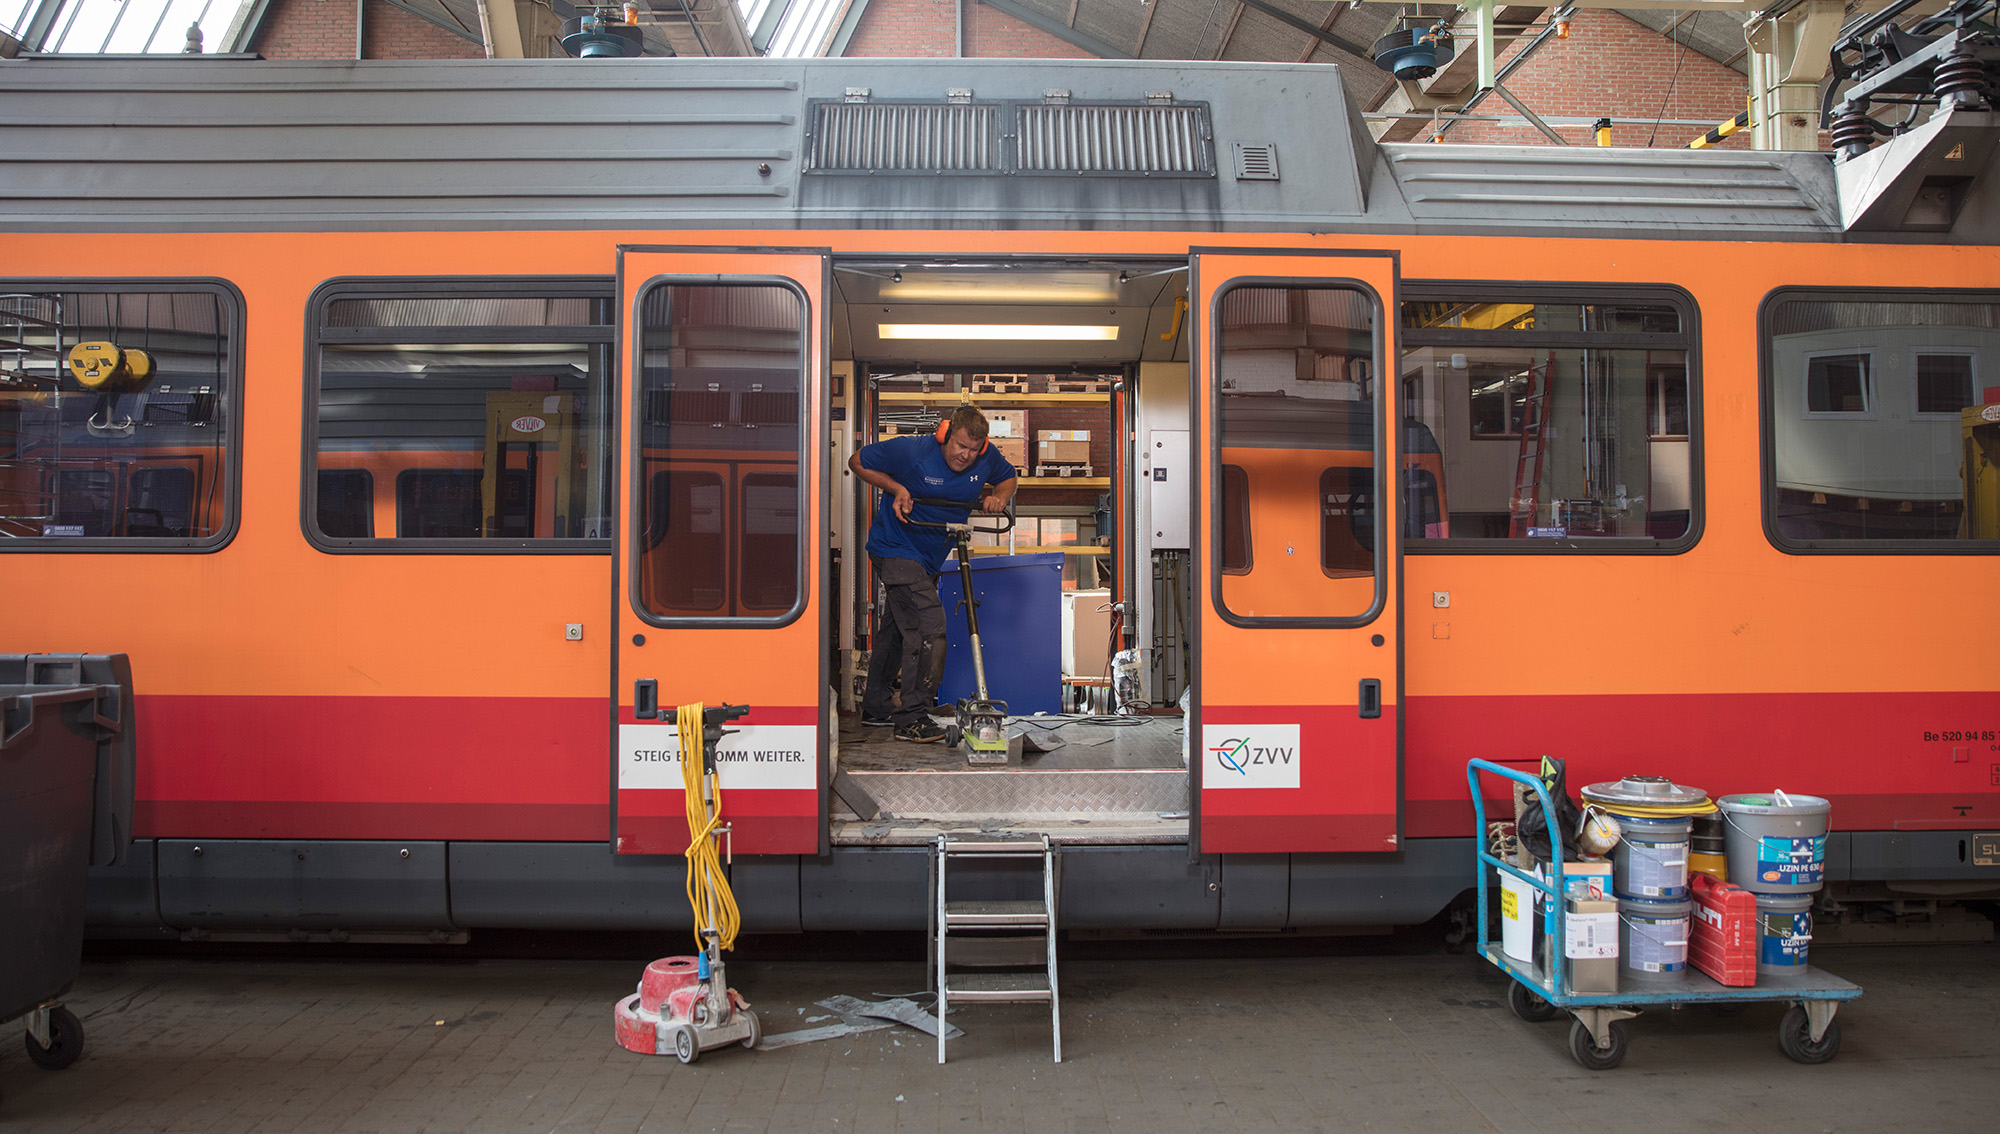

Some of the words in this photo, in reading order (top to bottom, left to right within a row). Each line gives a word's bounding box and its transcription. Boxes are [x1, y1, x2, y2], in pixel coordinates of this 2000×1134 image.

[1924, 731, 1939, 741] Be
[1942, 731, 1962, 741] 520
[1965, 731, 1978, 741] 94
[1981, 731, 1995, 741] 85
[634, 750, 671, 762] STEIG
[714, 750, 749, 762] OMM
[753, 750, 805, 762] WEITER.
[1253, 747, 1293, 765] ZVV
[1779, 864, 1800, 872] UZIN
[1692, 901, 1722, 930] ILTI
